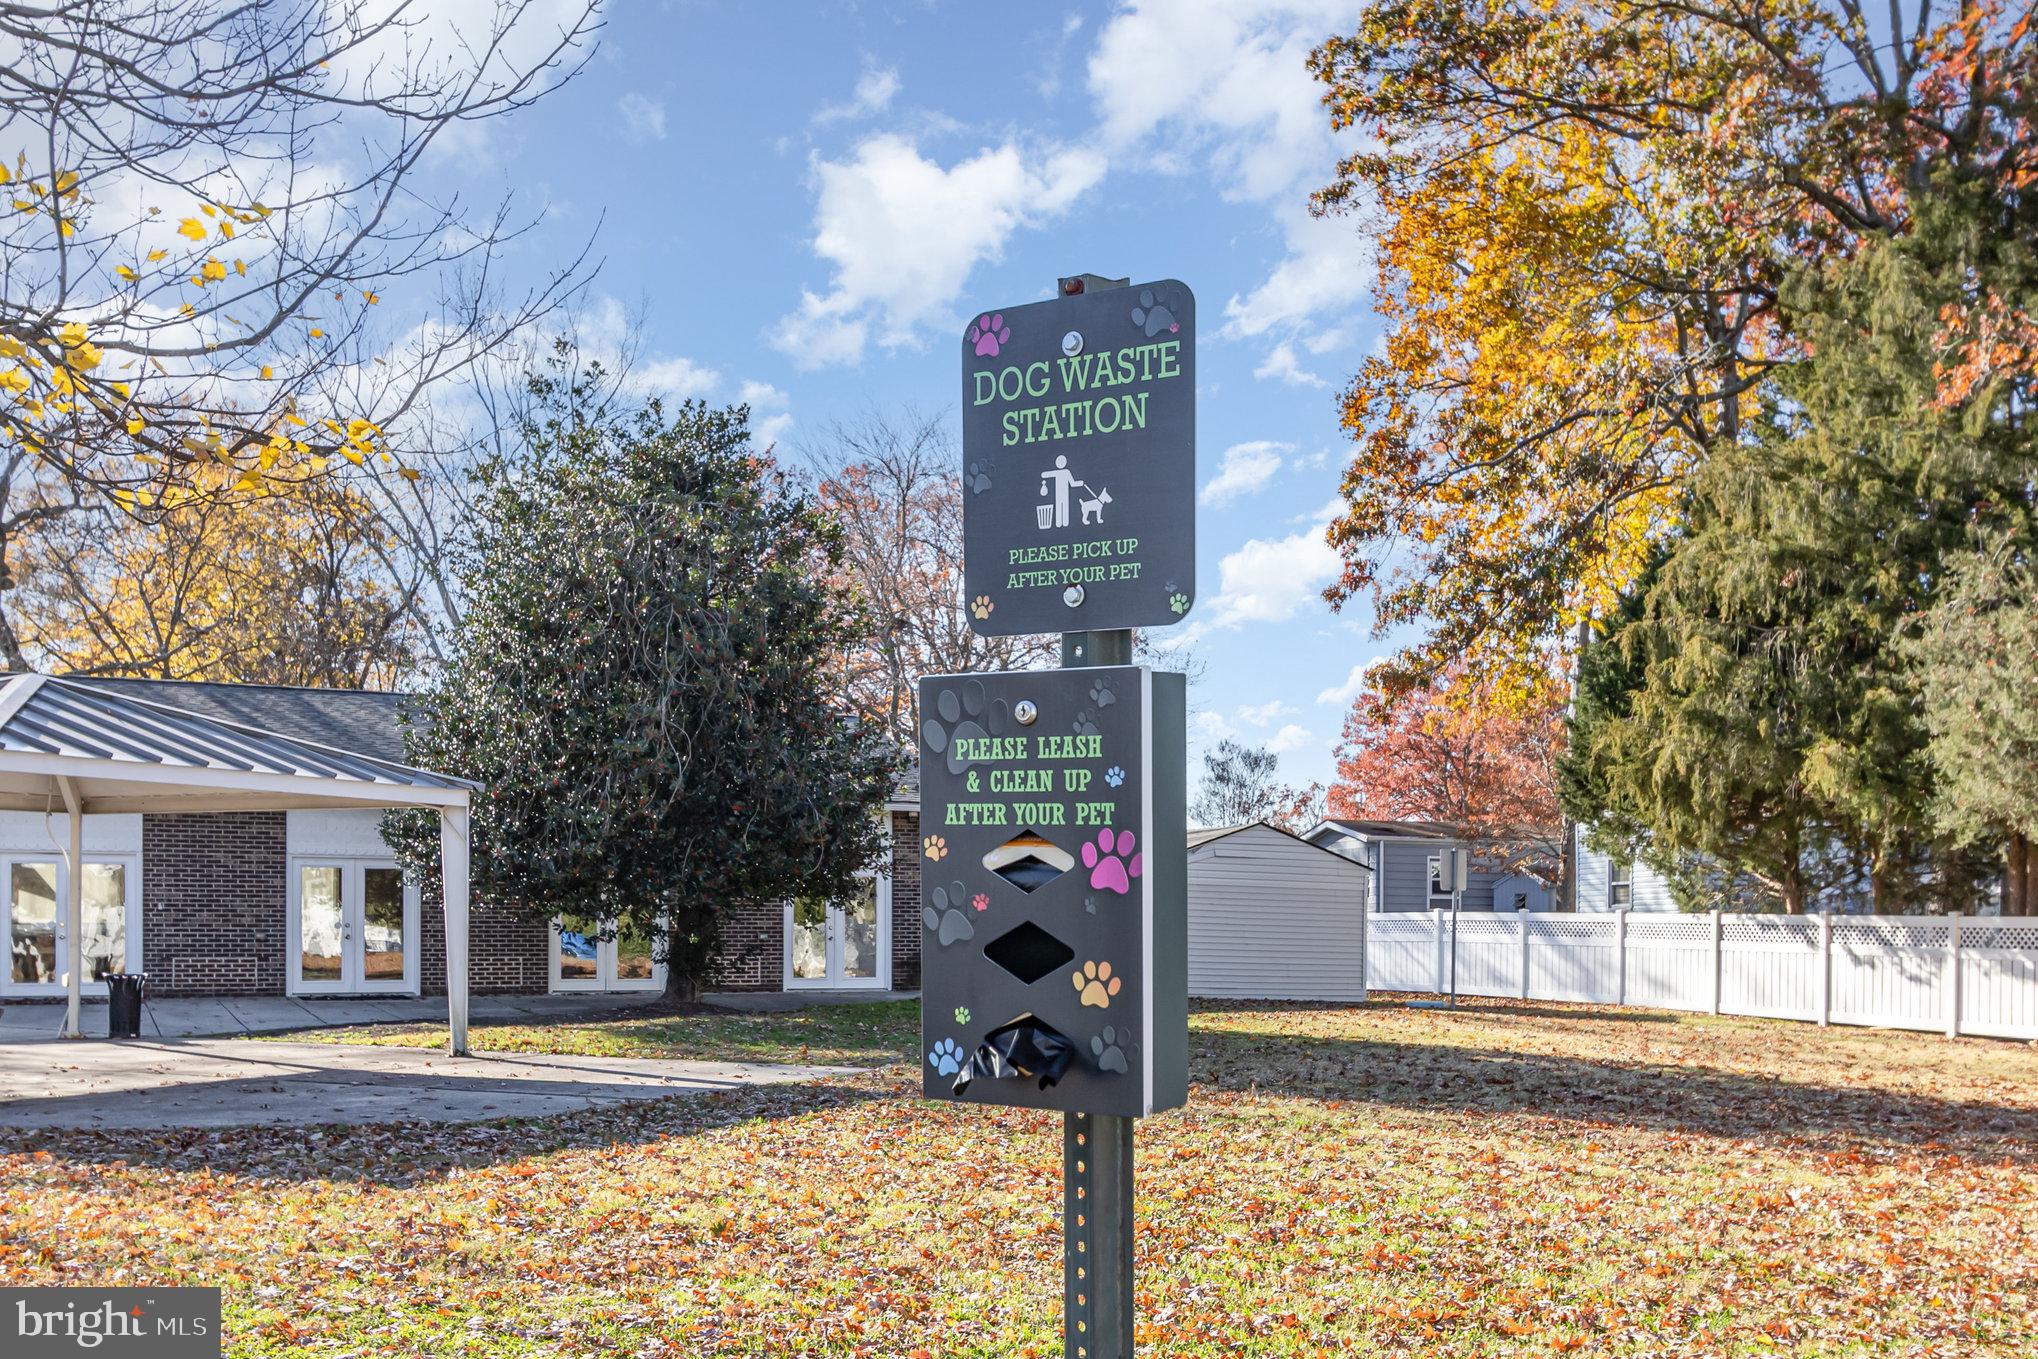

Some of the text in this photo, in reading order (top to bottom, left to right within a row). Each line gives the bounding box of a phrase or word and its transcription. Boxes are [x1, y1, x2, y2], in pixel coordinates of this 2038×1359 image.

[973, 340, 1181, 406] DOG WASTE
[1003, 392, 1150, 446] STATION
[1009, 538, 1139, 565] PLEASE PICK UP
[1007, 562, 1142, 589] AFTER YOUR PET
[955, 735, 1103, 761] PLEASE LEASH
[966, 769, 1092, 793] & CLEAN UP
[945, 802, 1115, 826] AFTER YOUR PET
